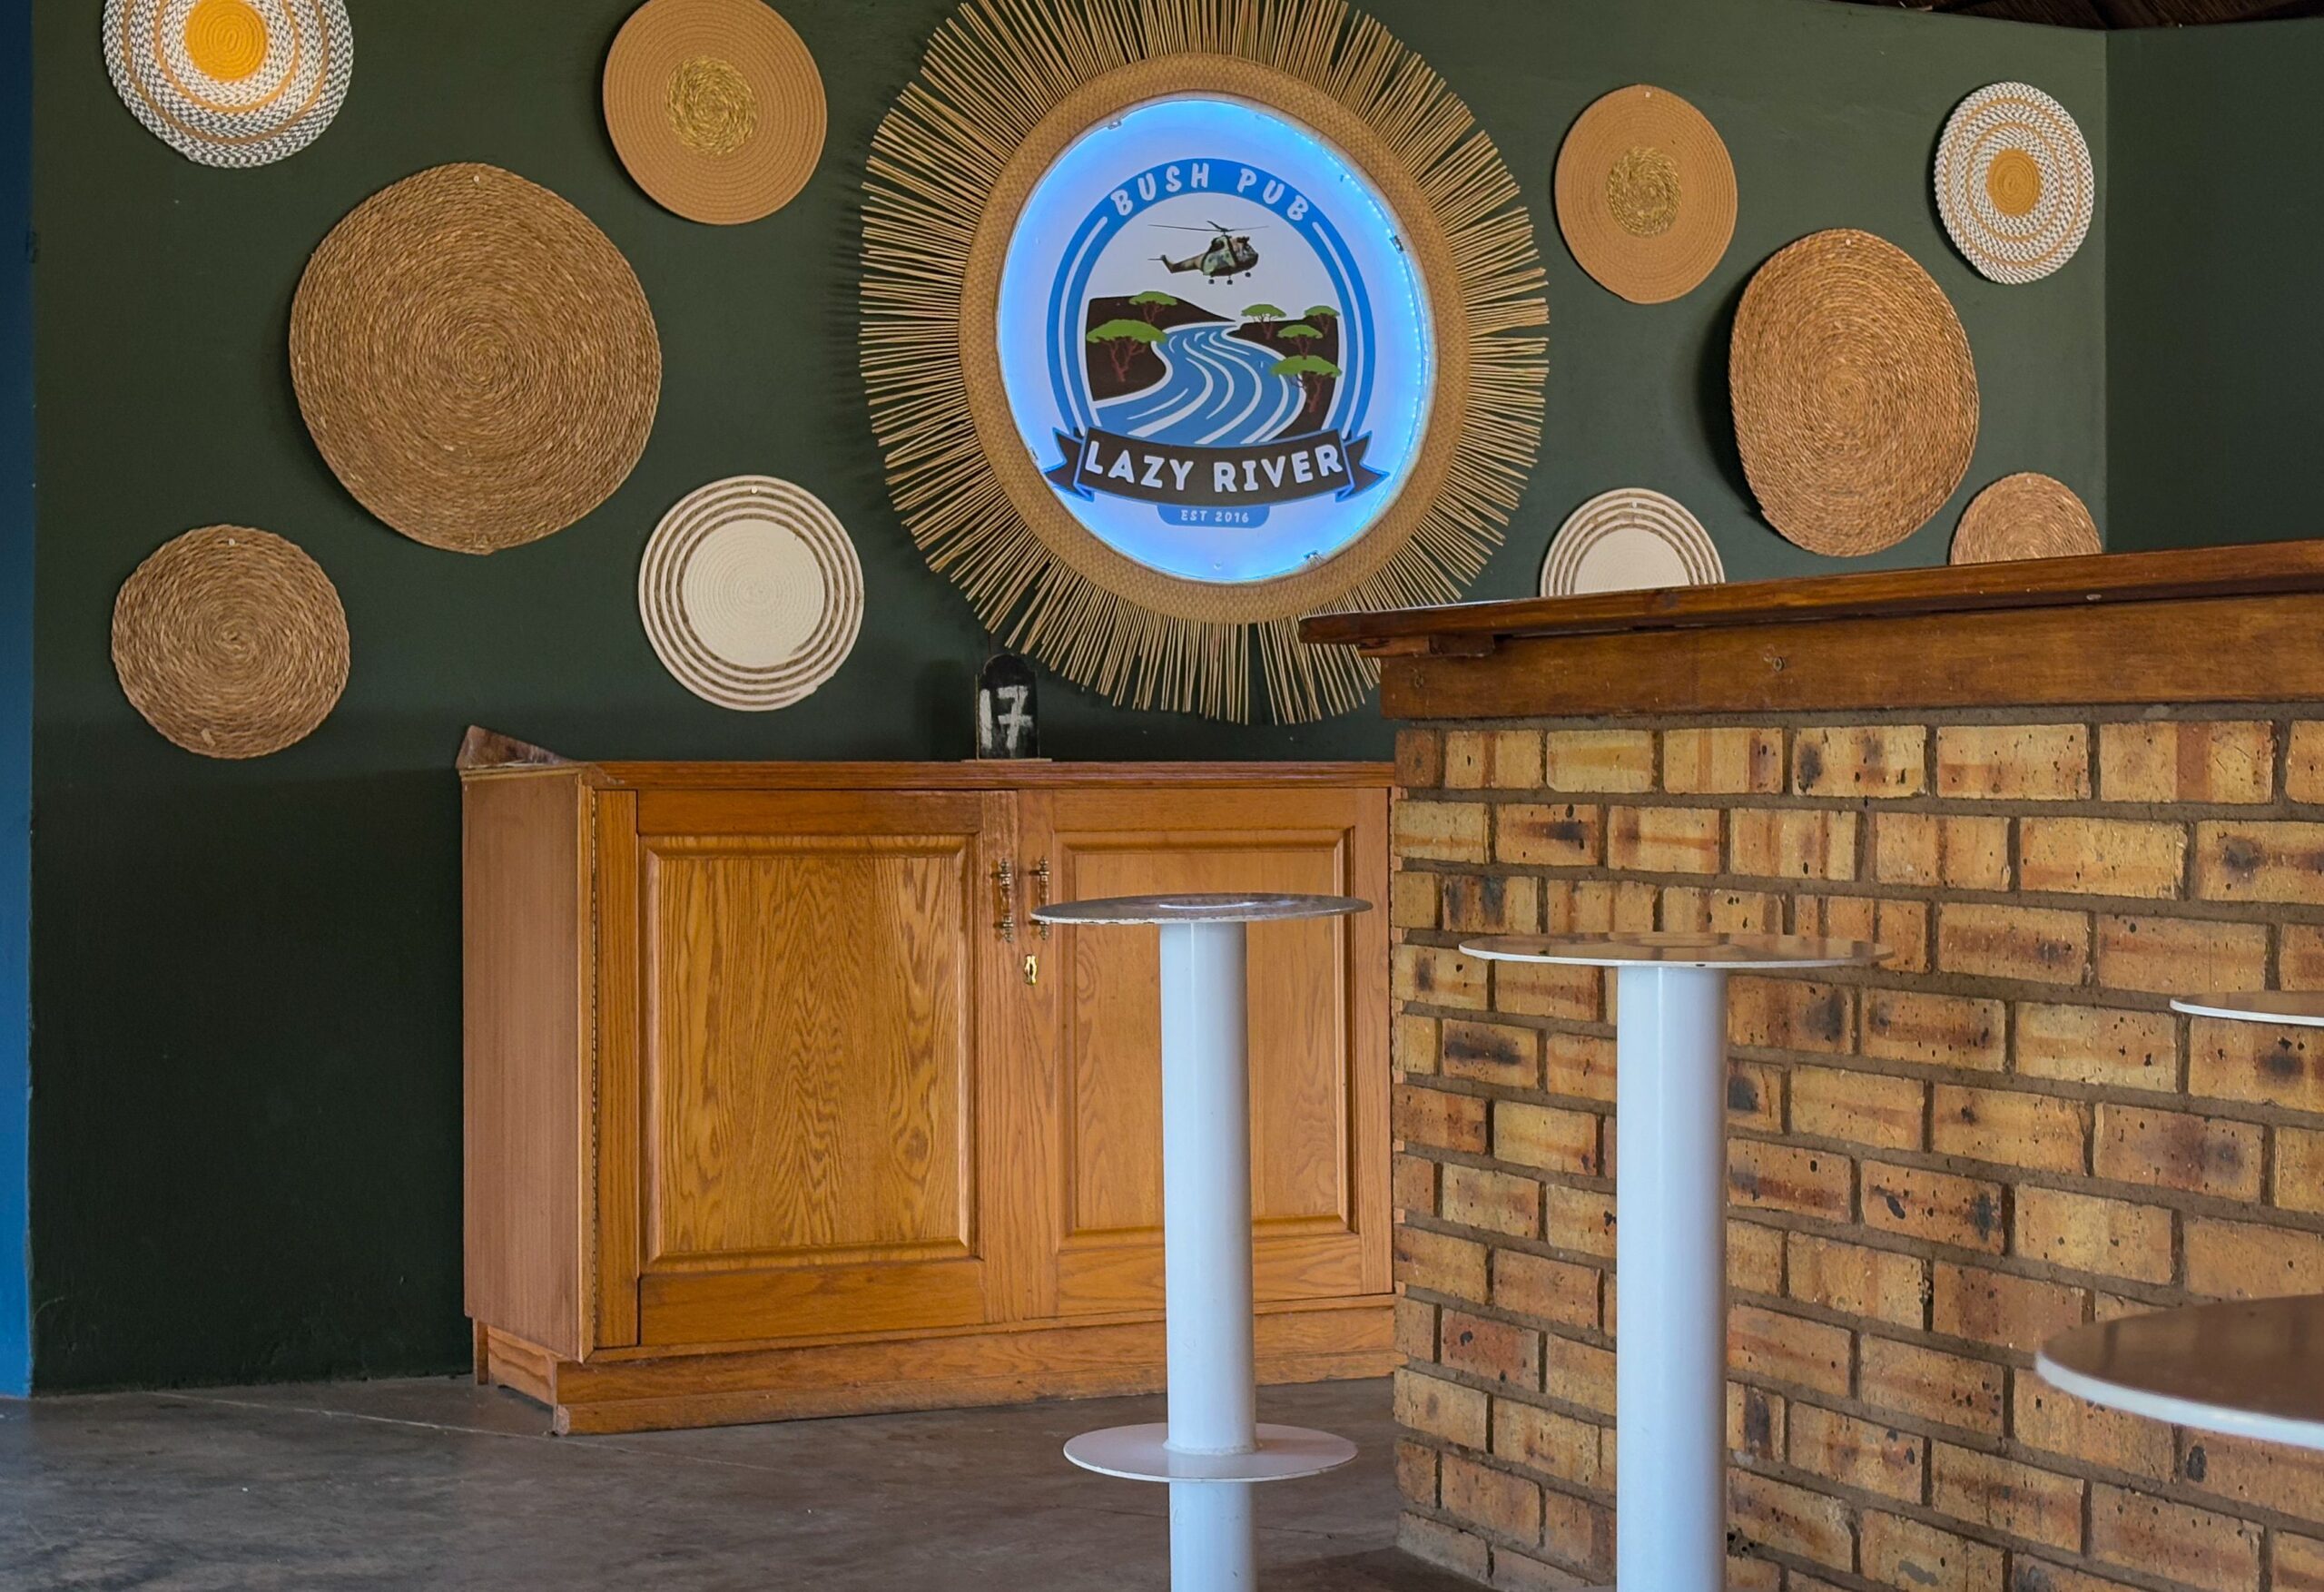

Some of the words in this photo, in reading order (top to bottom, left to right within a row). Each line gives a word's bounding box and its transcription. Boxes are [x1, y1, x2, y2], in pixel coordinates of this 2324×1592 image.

[1110, 162, 1210, 217] BUSH
[1236, 167, 1310, 221] PUB
[1084, 440, 1194, 491] LAZY
[1213, 443, 1344, 493] RIVER
[1180, 509, 1207, 522] EST
[1215, 510, 1249, 524] 2016
[979, 684, 1033, 750] 17
